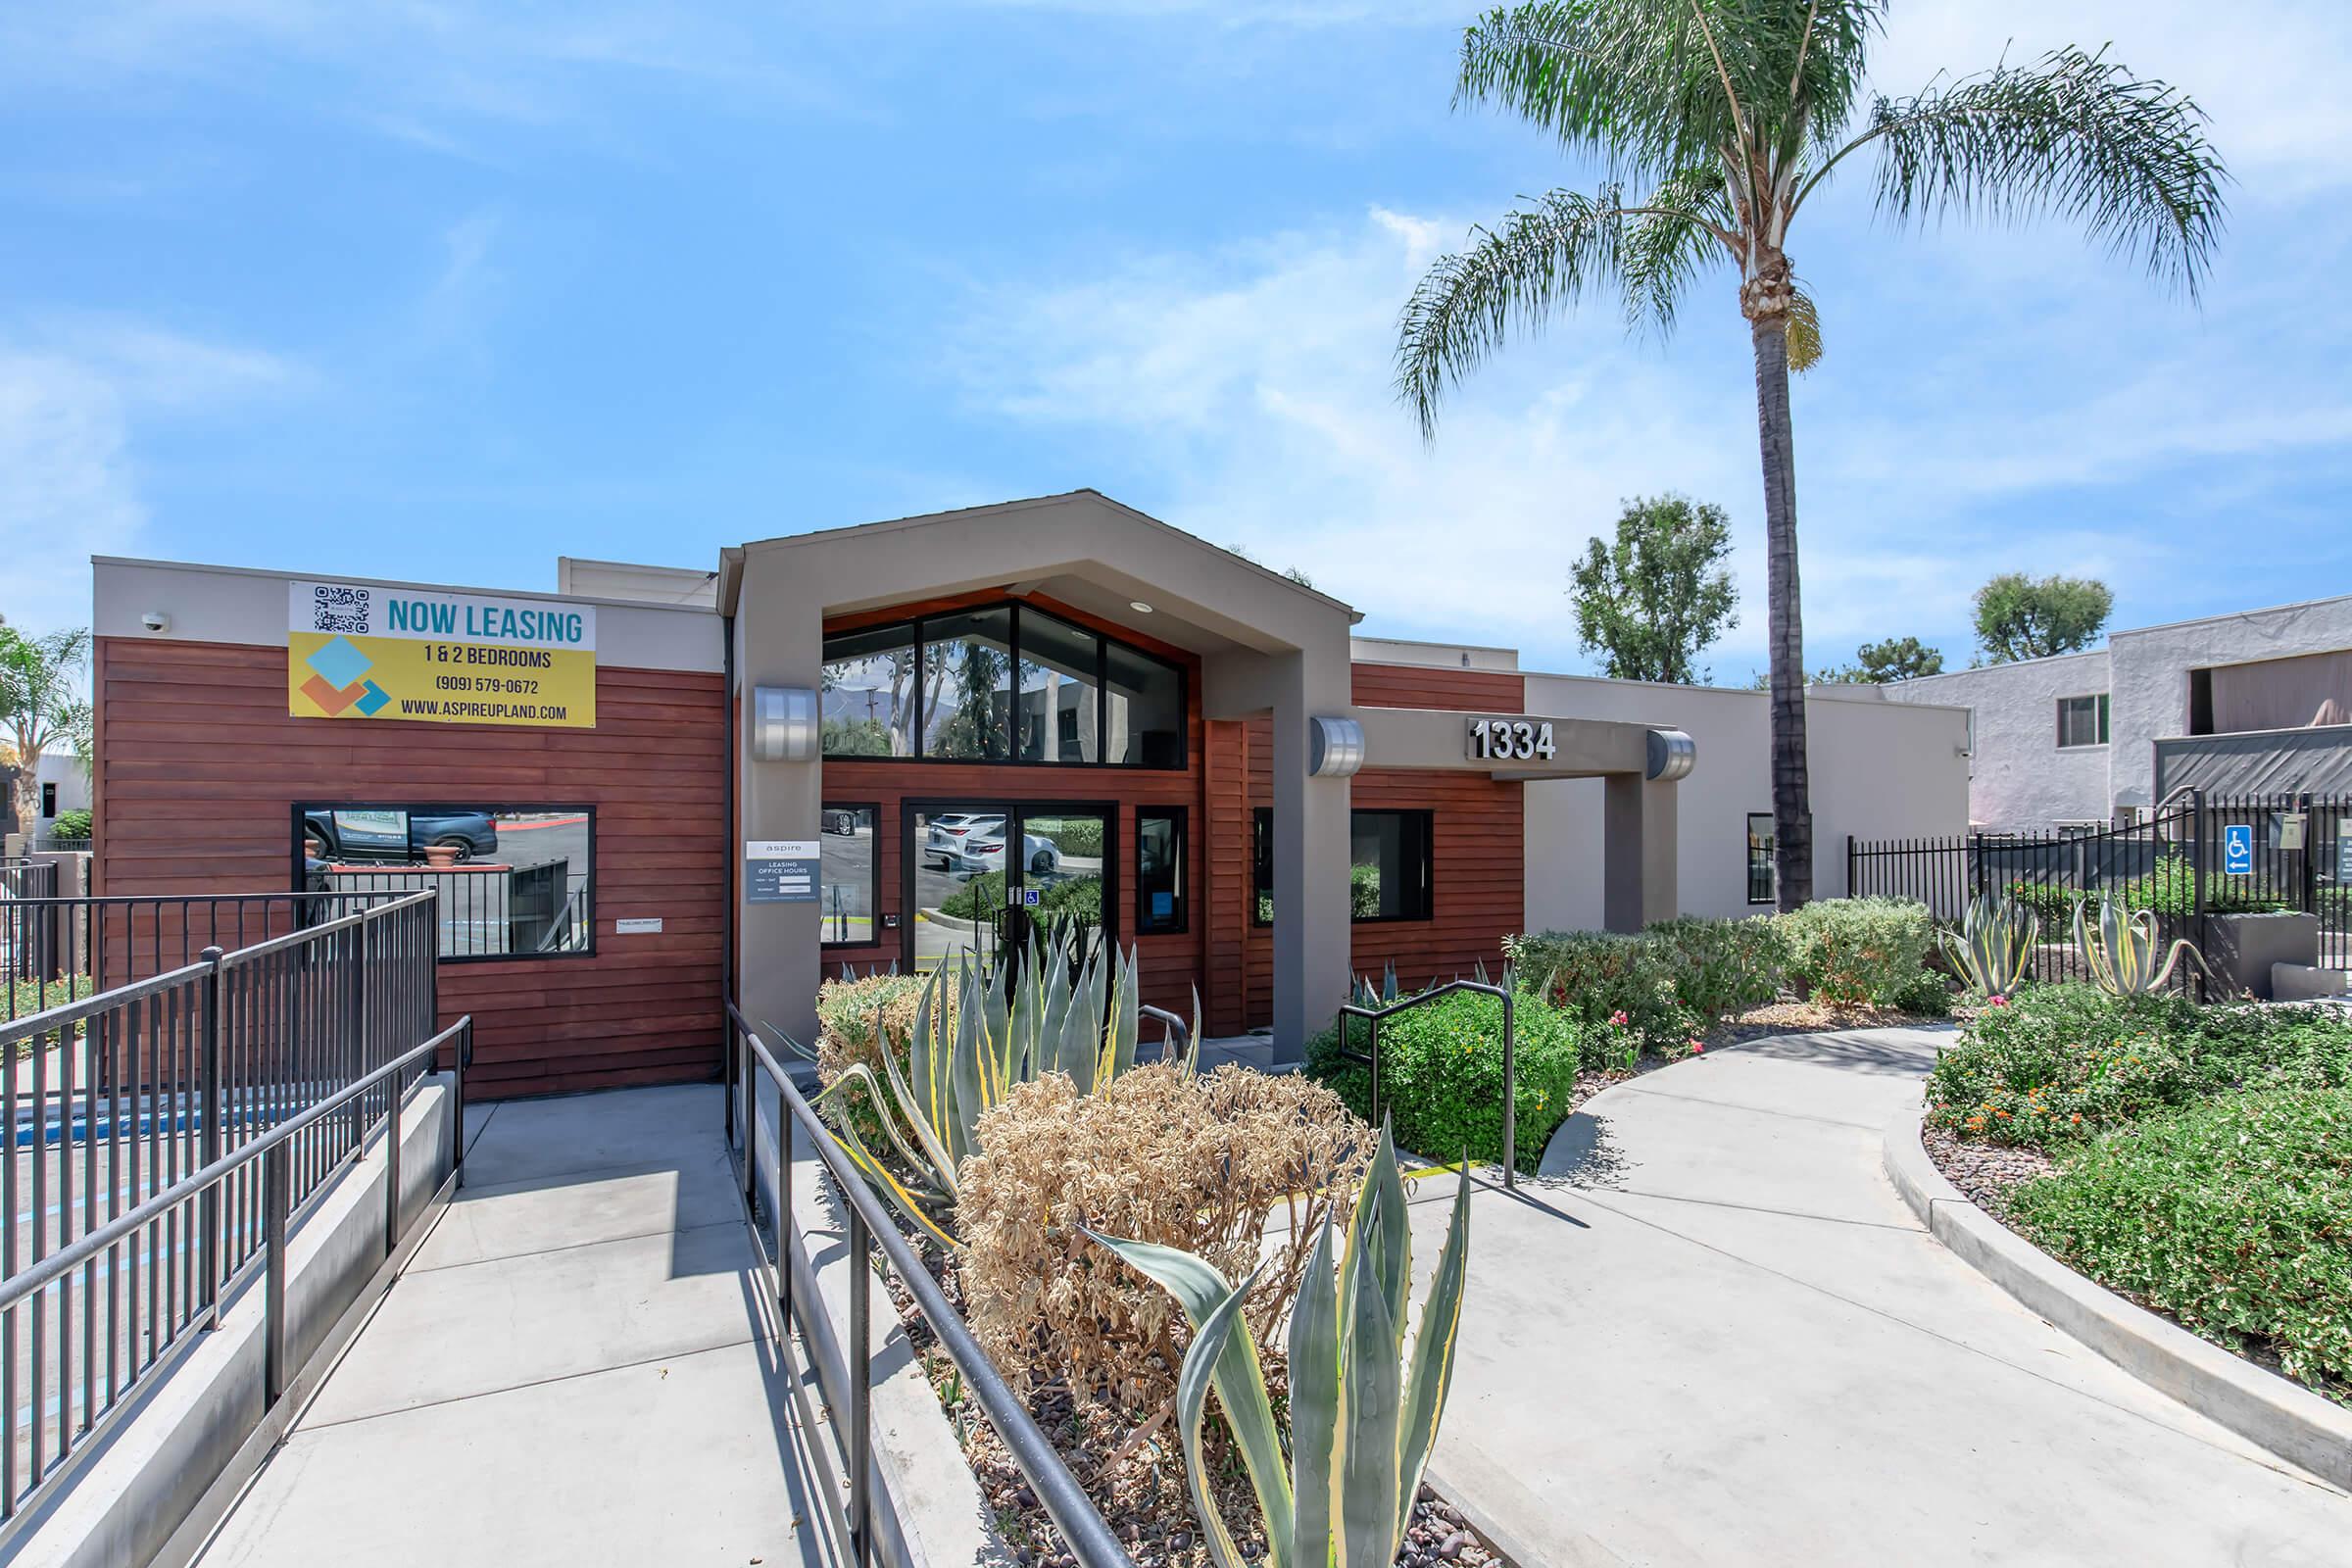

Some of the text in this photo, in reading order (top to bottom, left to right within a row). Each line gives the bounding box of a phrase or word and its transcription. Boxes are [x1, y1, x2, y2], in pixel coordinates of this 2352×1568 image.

[389, 600, 583, 643] NOW LEASING
[424, 645, 551, 668] 1 & 2 BEDROOMS
[436, 675, 538, 694] (909) 579-0672
[401, 700, 566, 720] WWW.ASPIREUPLAND.COM
[1474, 720, 1556, 760] 1334
